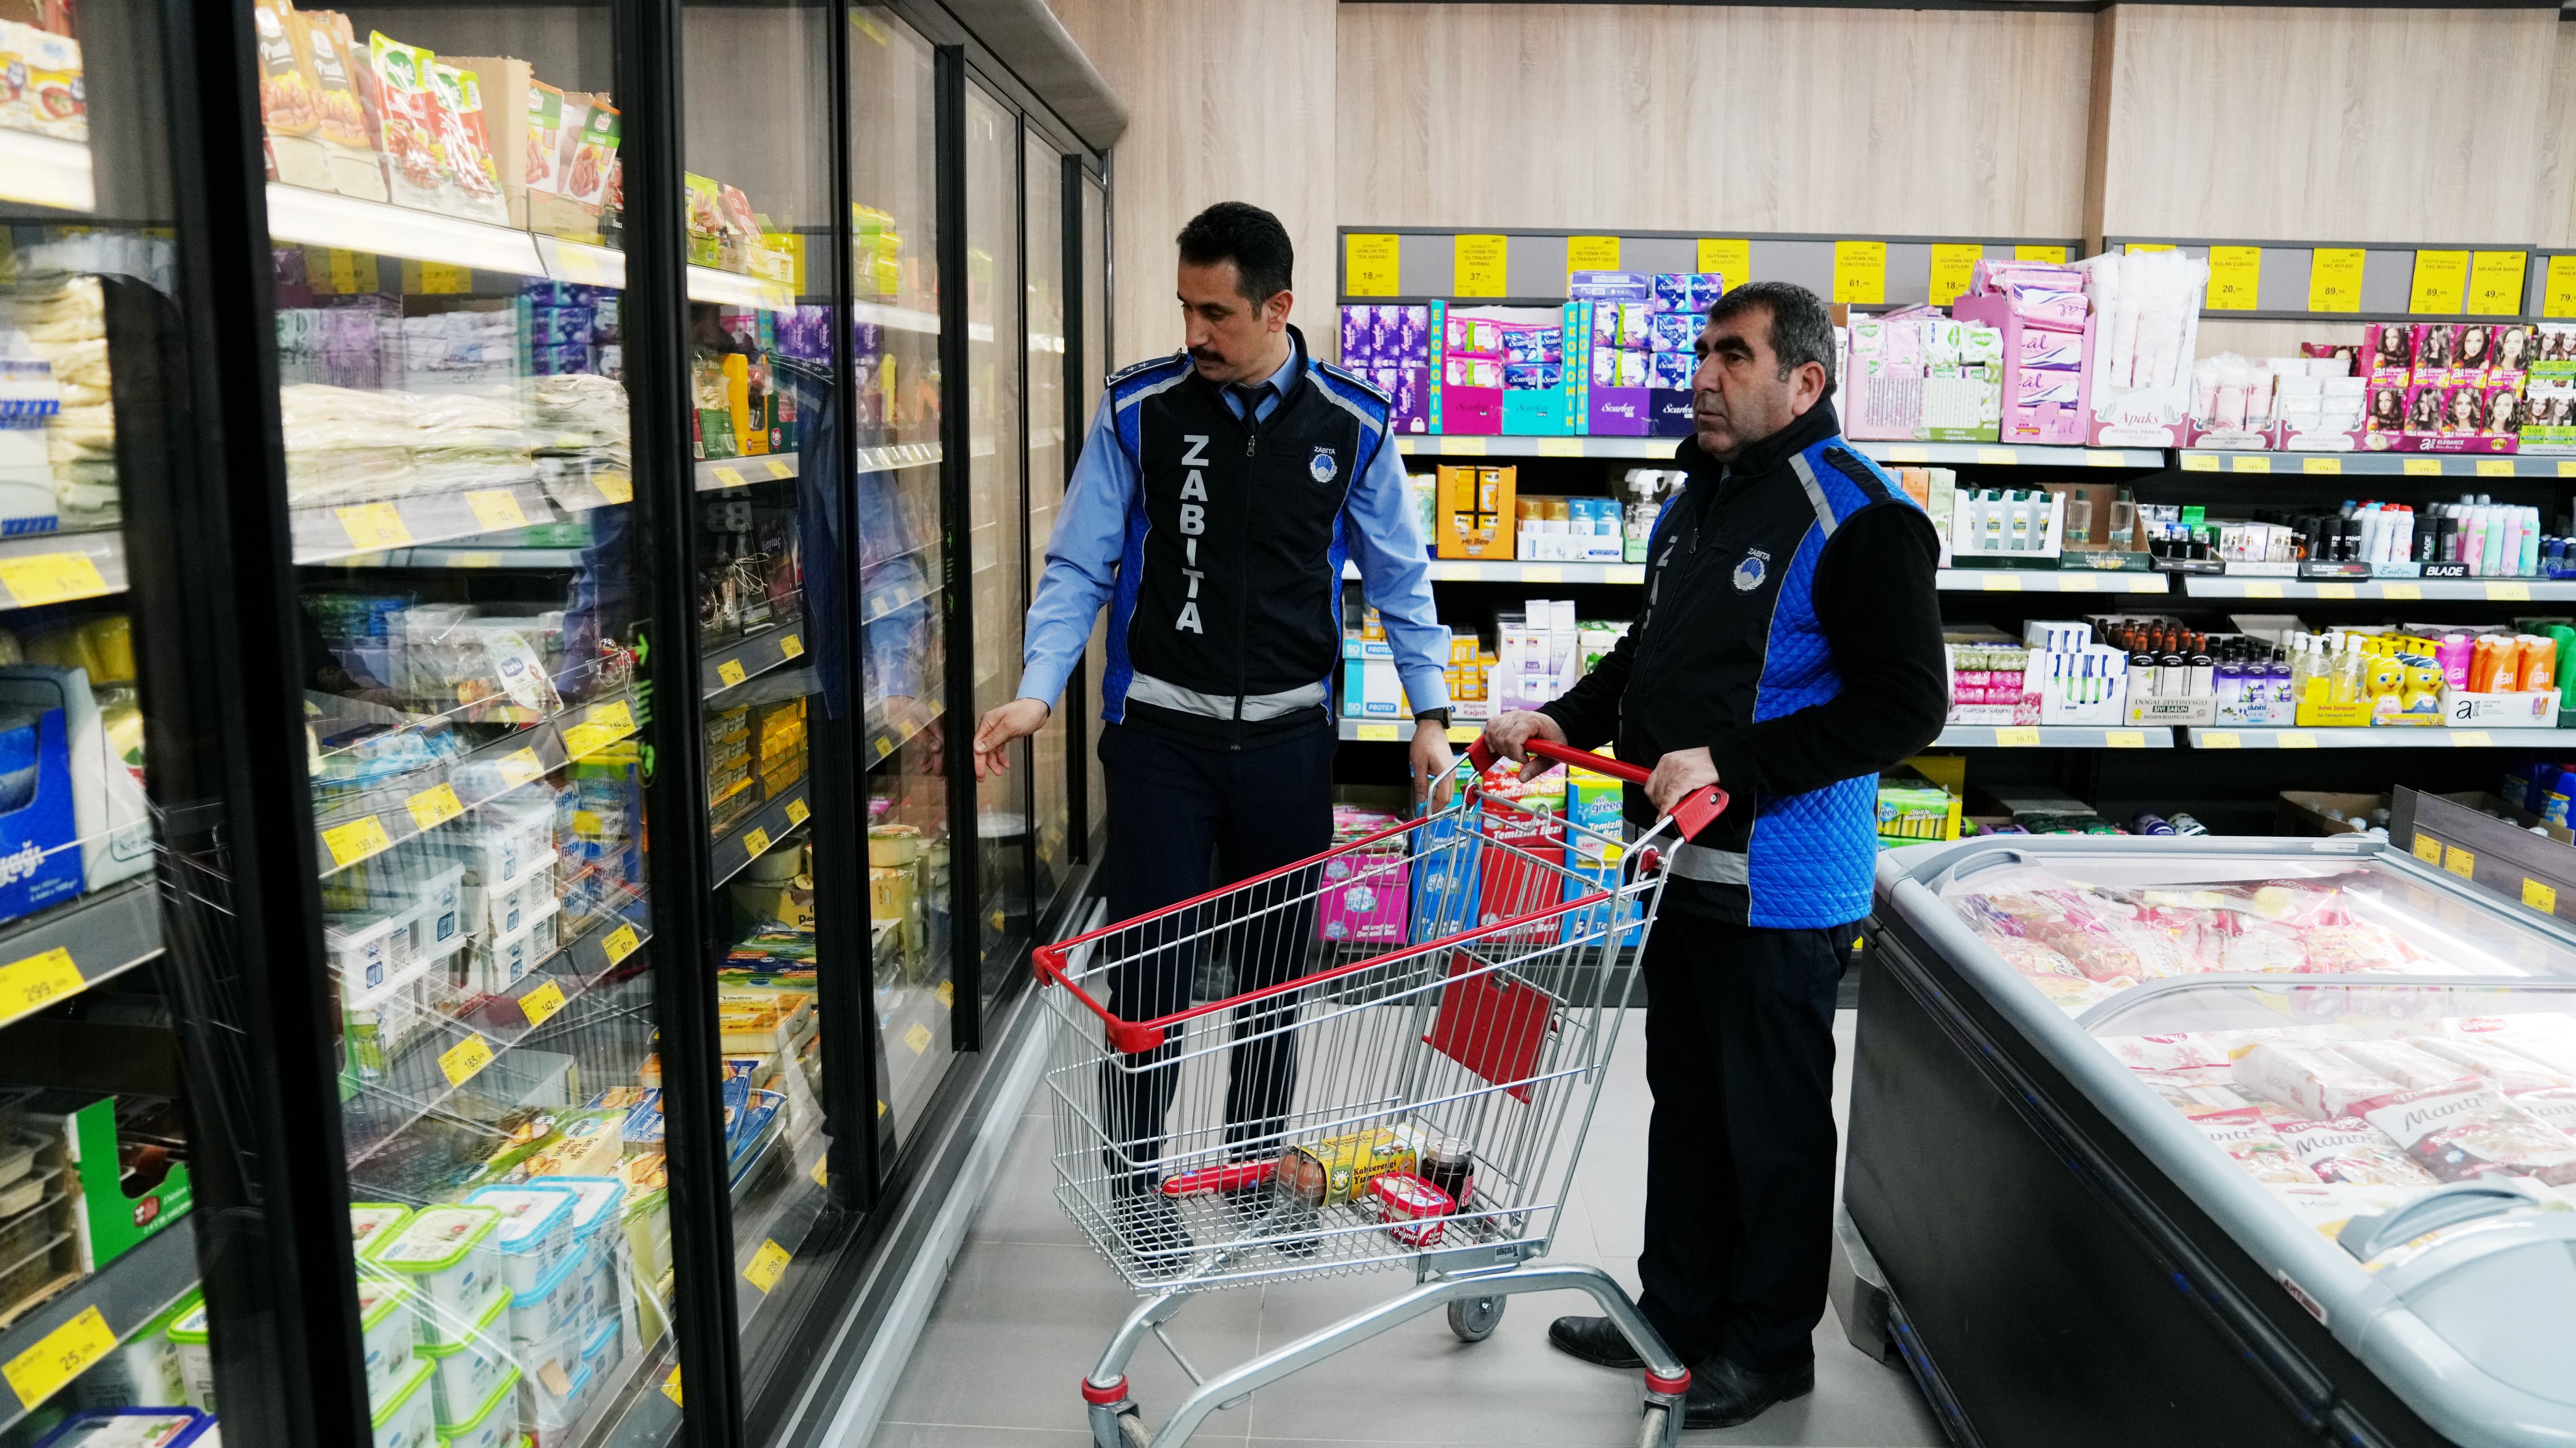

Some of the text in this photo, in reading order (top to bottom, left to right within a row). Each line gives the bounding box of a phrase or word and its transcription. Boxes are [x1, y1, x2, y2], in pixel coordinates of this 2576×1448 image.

[1431, 309, 1442, 426] EKONOMİK
[1566, 310, 1577, 427] EKONOMİK
[1577, 308, 1589, 425] EKONOMİK
[1601, 402, 1635, 413] Scarlett
[2119, 411, 2160, 426] Apaks
[1313, 445, 1336, 455] ZABITA
[1175, 434, 1210, 635] ZABITA
[1473, 538, 1491, 546] Bee
[2423, 534, 2432, 561] BLADE
[1747, 546, 1771, 562] ZABITA
[2425, 566, 2464, 577] BLADE
[1368, 703, 1395, 712] PROTEX
[1592, 801, 1623, 814] green
[1588, 818, 1623, 831] Temizli
[1346, 897, 1375, 910] green
[2296, 1134, 2367, 1158] Mantı
[1353, 1159, 1396, 1176] Kahverengi
[1496, 1245, 1517, 1256] gökçelik
